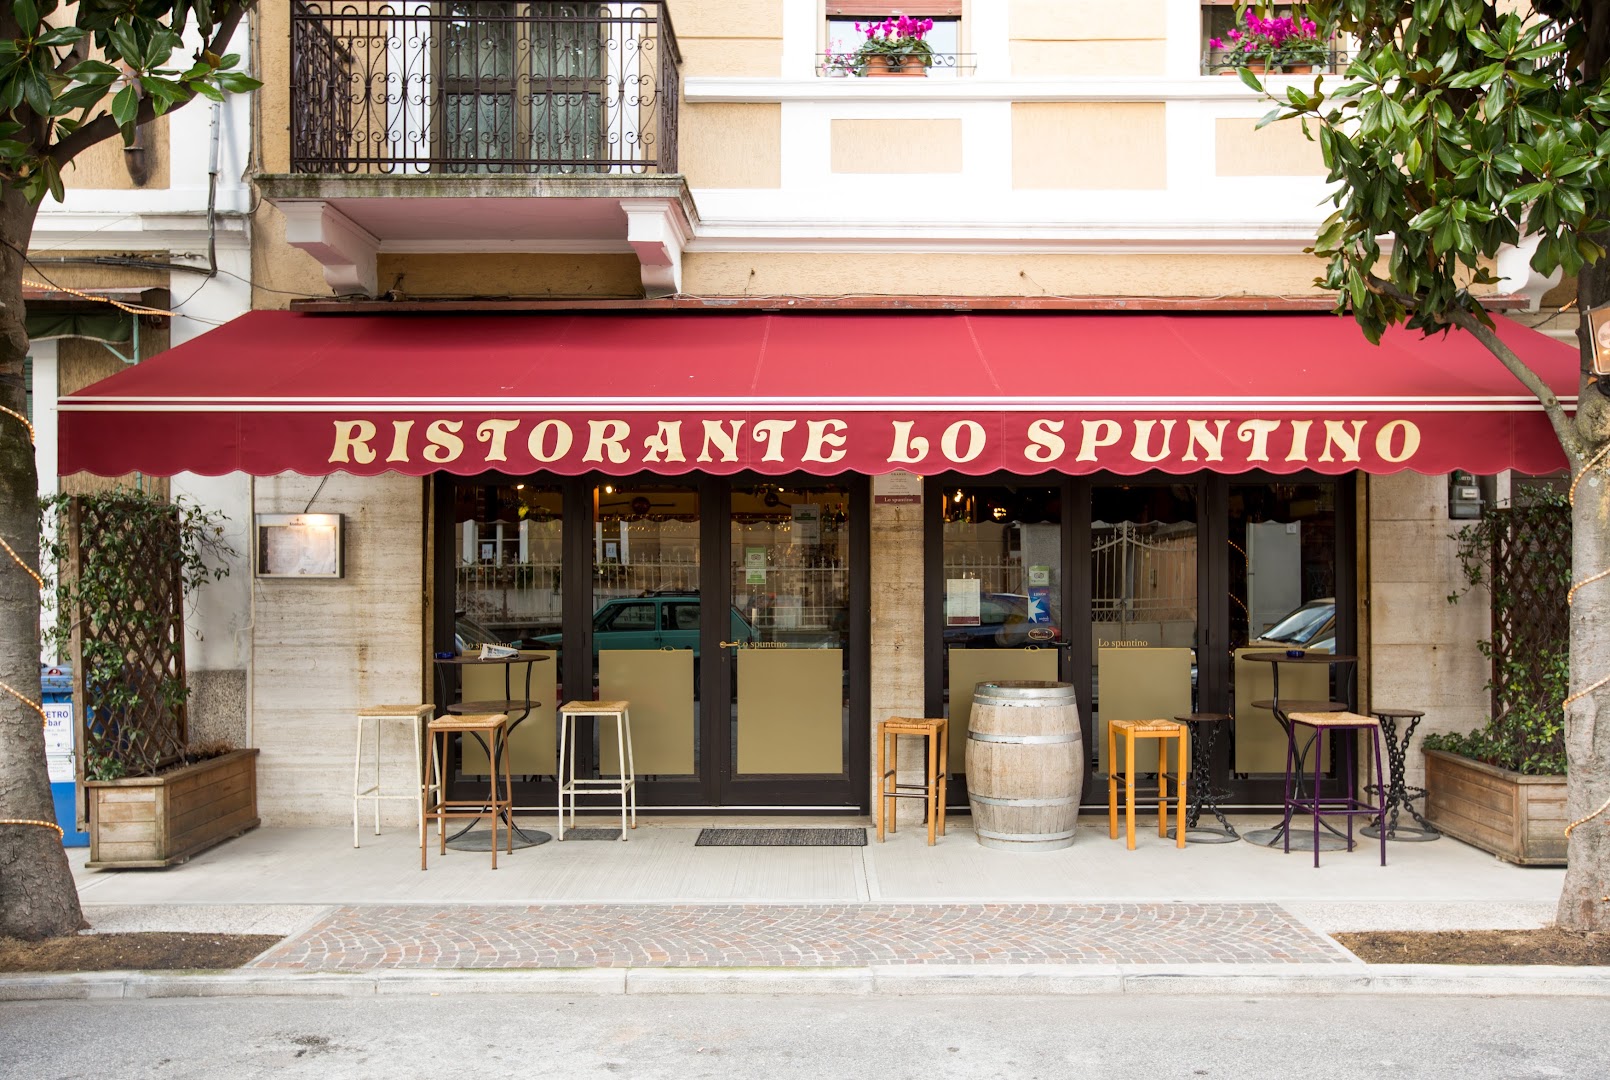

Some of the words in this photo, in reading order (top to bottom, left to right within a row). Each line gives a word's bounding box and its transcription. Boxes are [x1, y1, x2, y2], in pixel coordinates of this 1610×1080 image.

[327, 418, 848, 464] RISTORANTE
[886, 419, 987, 463] LO
[1023, 418, 1421, 463] SPUNTINO
[737, 639, 748, 649] Lo
[750, 639, 788, 649] spuntino
[1098, 638, 1110, 647] Lo
[1111, 638, 1148, 649] spuntino
[46, 710, 69, 719] ETRO
[48, 719, 62, 727] bar
